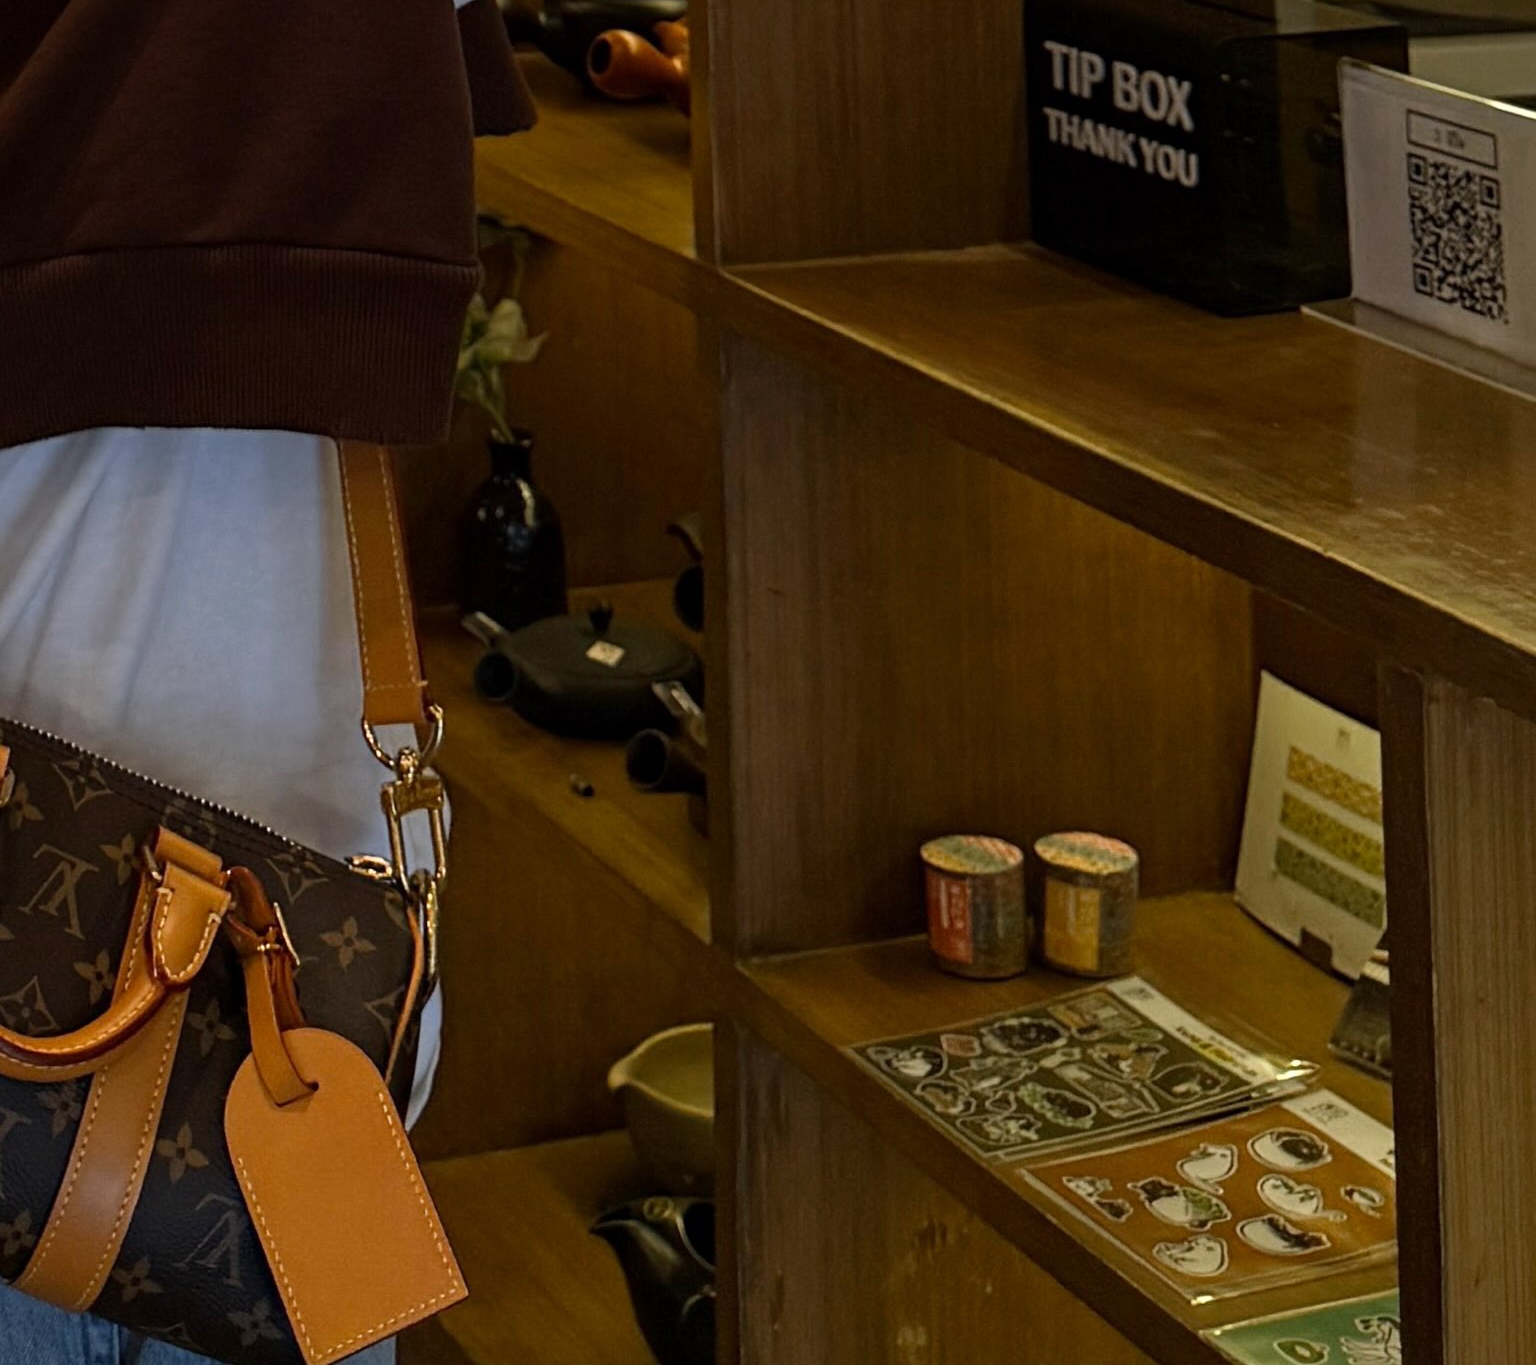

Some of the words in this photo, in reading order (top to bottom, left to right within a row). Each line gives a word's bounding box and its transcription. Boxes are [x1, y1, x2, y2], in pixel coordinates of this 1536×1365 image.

[1043, 39, 1106, 100] TIP
[1111, 60, 1195, 133] BOX
[1042, 106, 1138, 169] THANK
[1138, 135, 1200, 189] YOU
